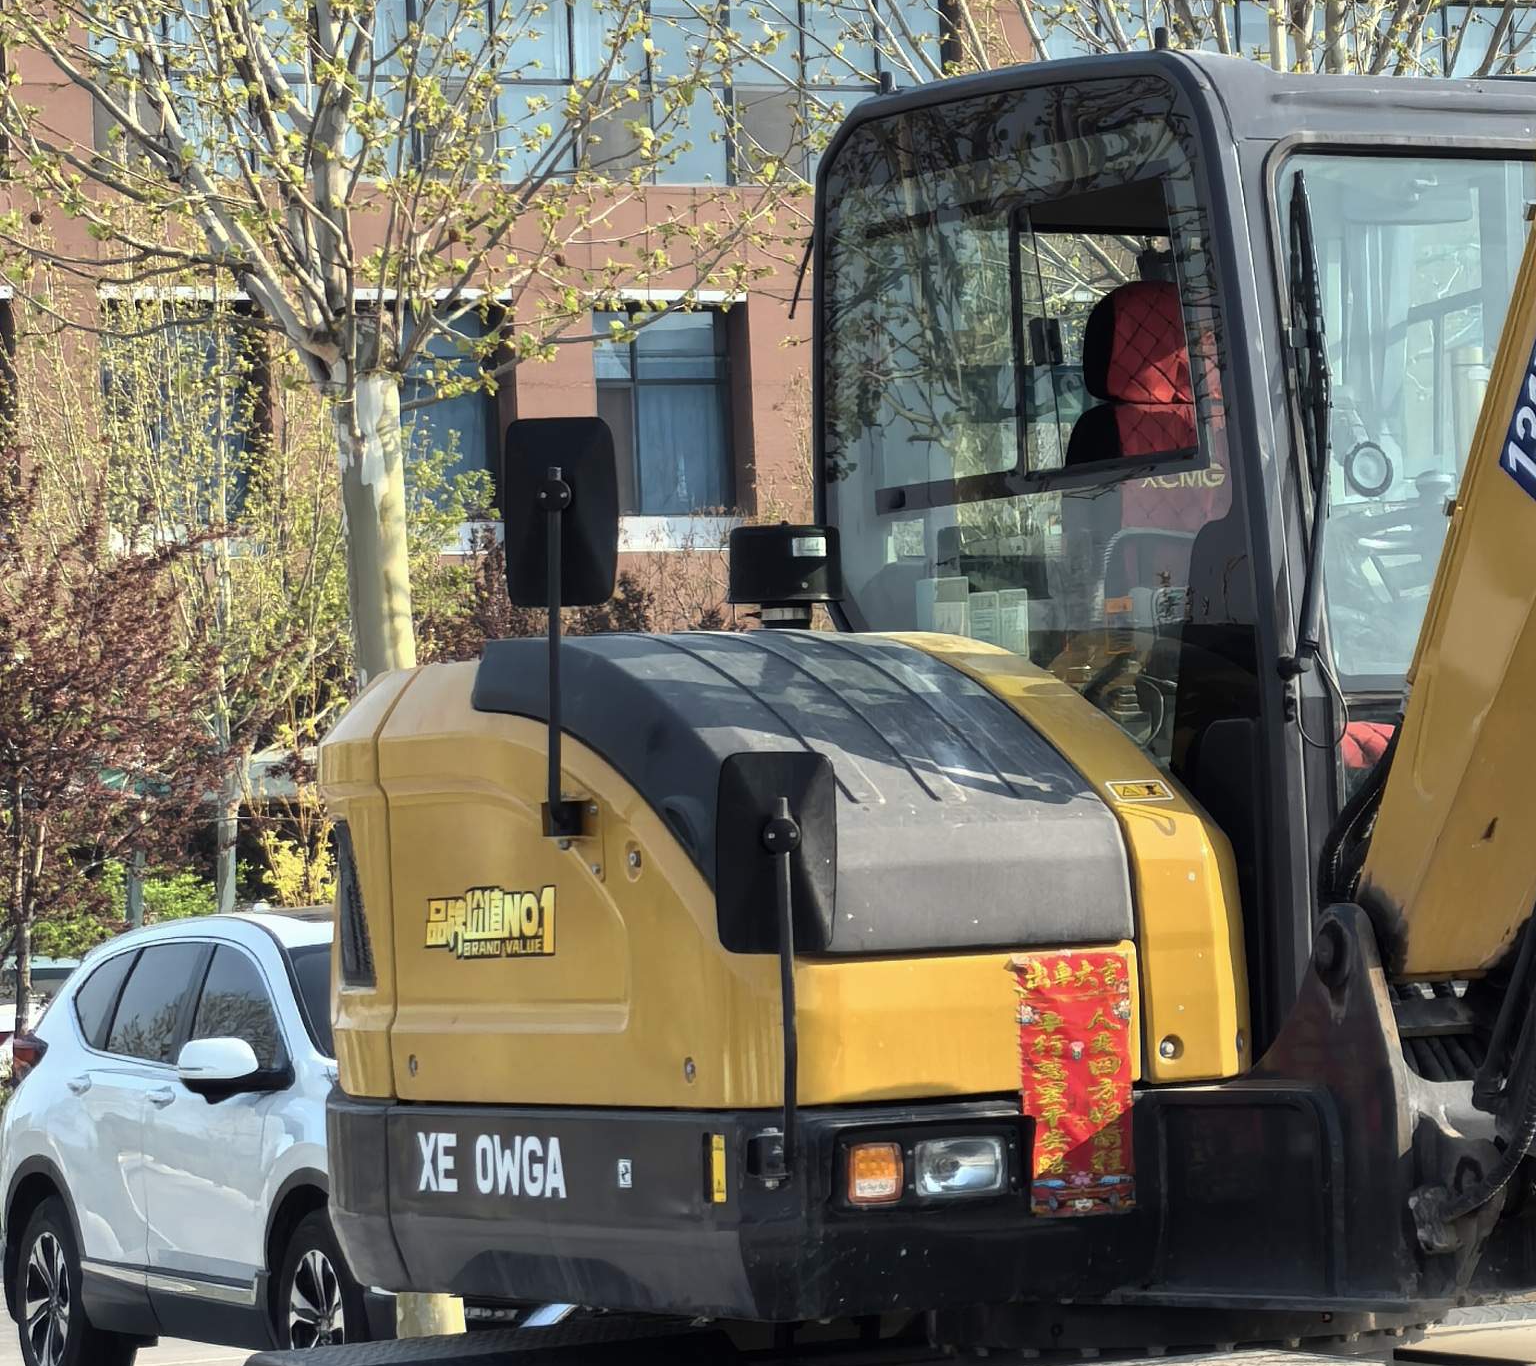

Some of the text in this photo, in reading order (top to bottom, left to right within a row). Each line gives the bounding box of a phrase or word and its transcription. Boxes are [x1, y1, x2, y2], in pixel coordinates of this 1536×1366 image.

[464, 939, 543, 956] BRAND VALUE
[417, 1132, 458, 1192] XE
